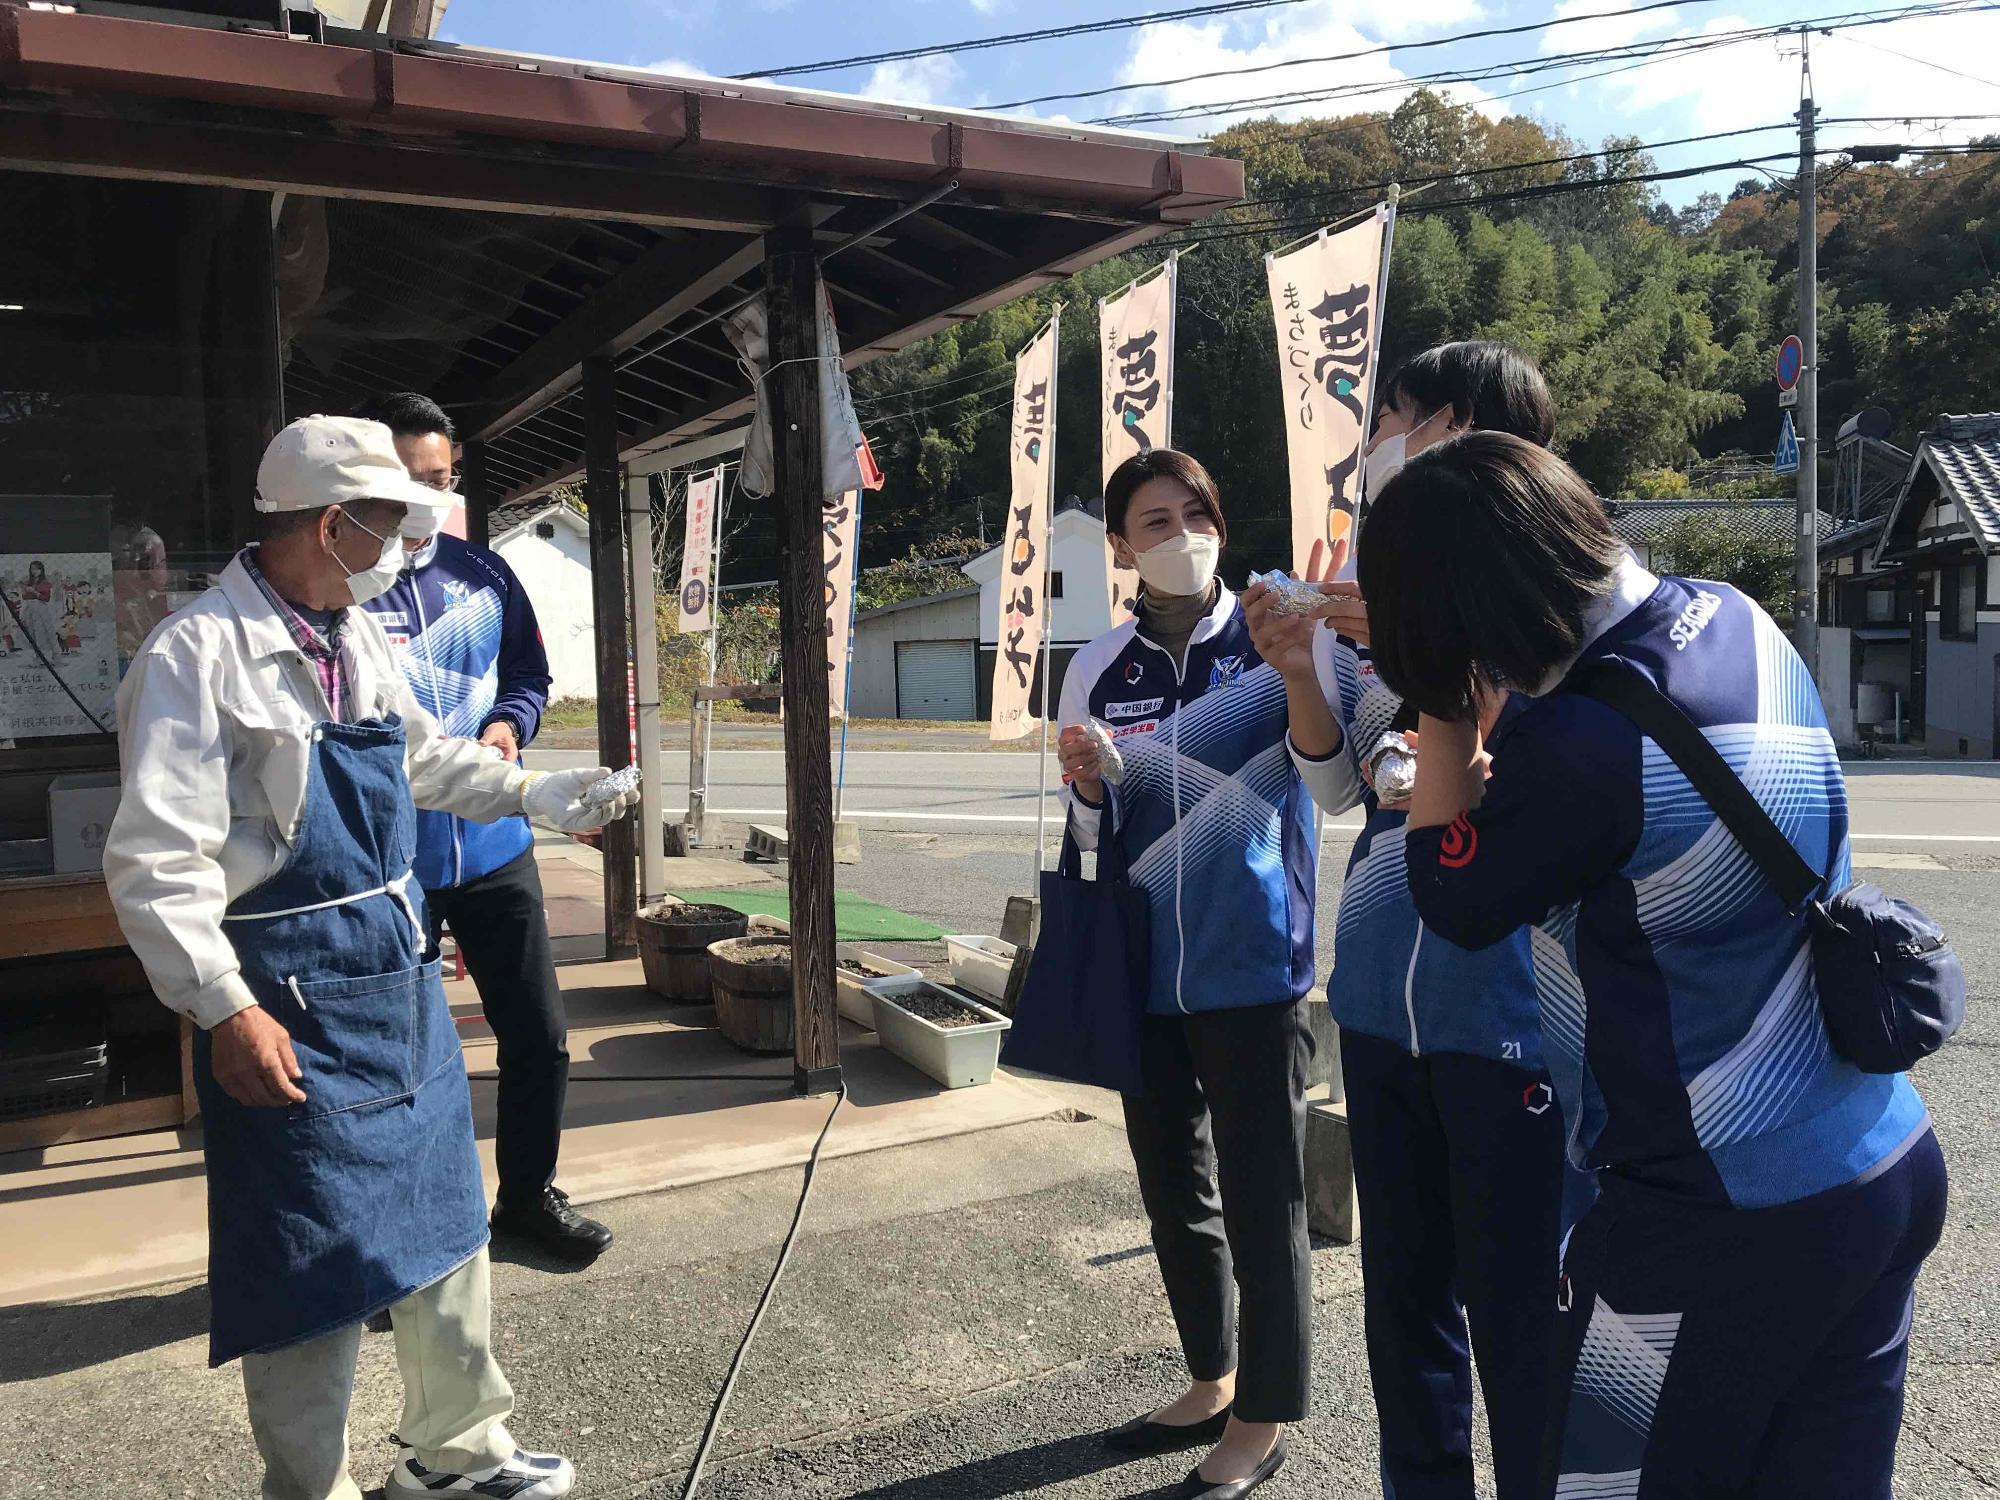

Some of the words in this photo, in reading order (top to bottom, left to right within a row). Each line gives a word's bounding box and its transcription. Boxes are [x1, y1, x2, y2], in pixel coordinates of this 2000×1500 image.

[1121, 700, 1163, 714] 中国銀行
[1112, 722, 1156, 739] ンボ学生服
[1501, 1041, 1522, 1059] 21
